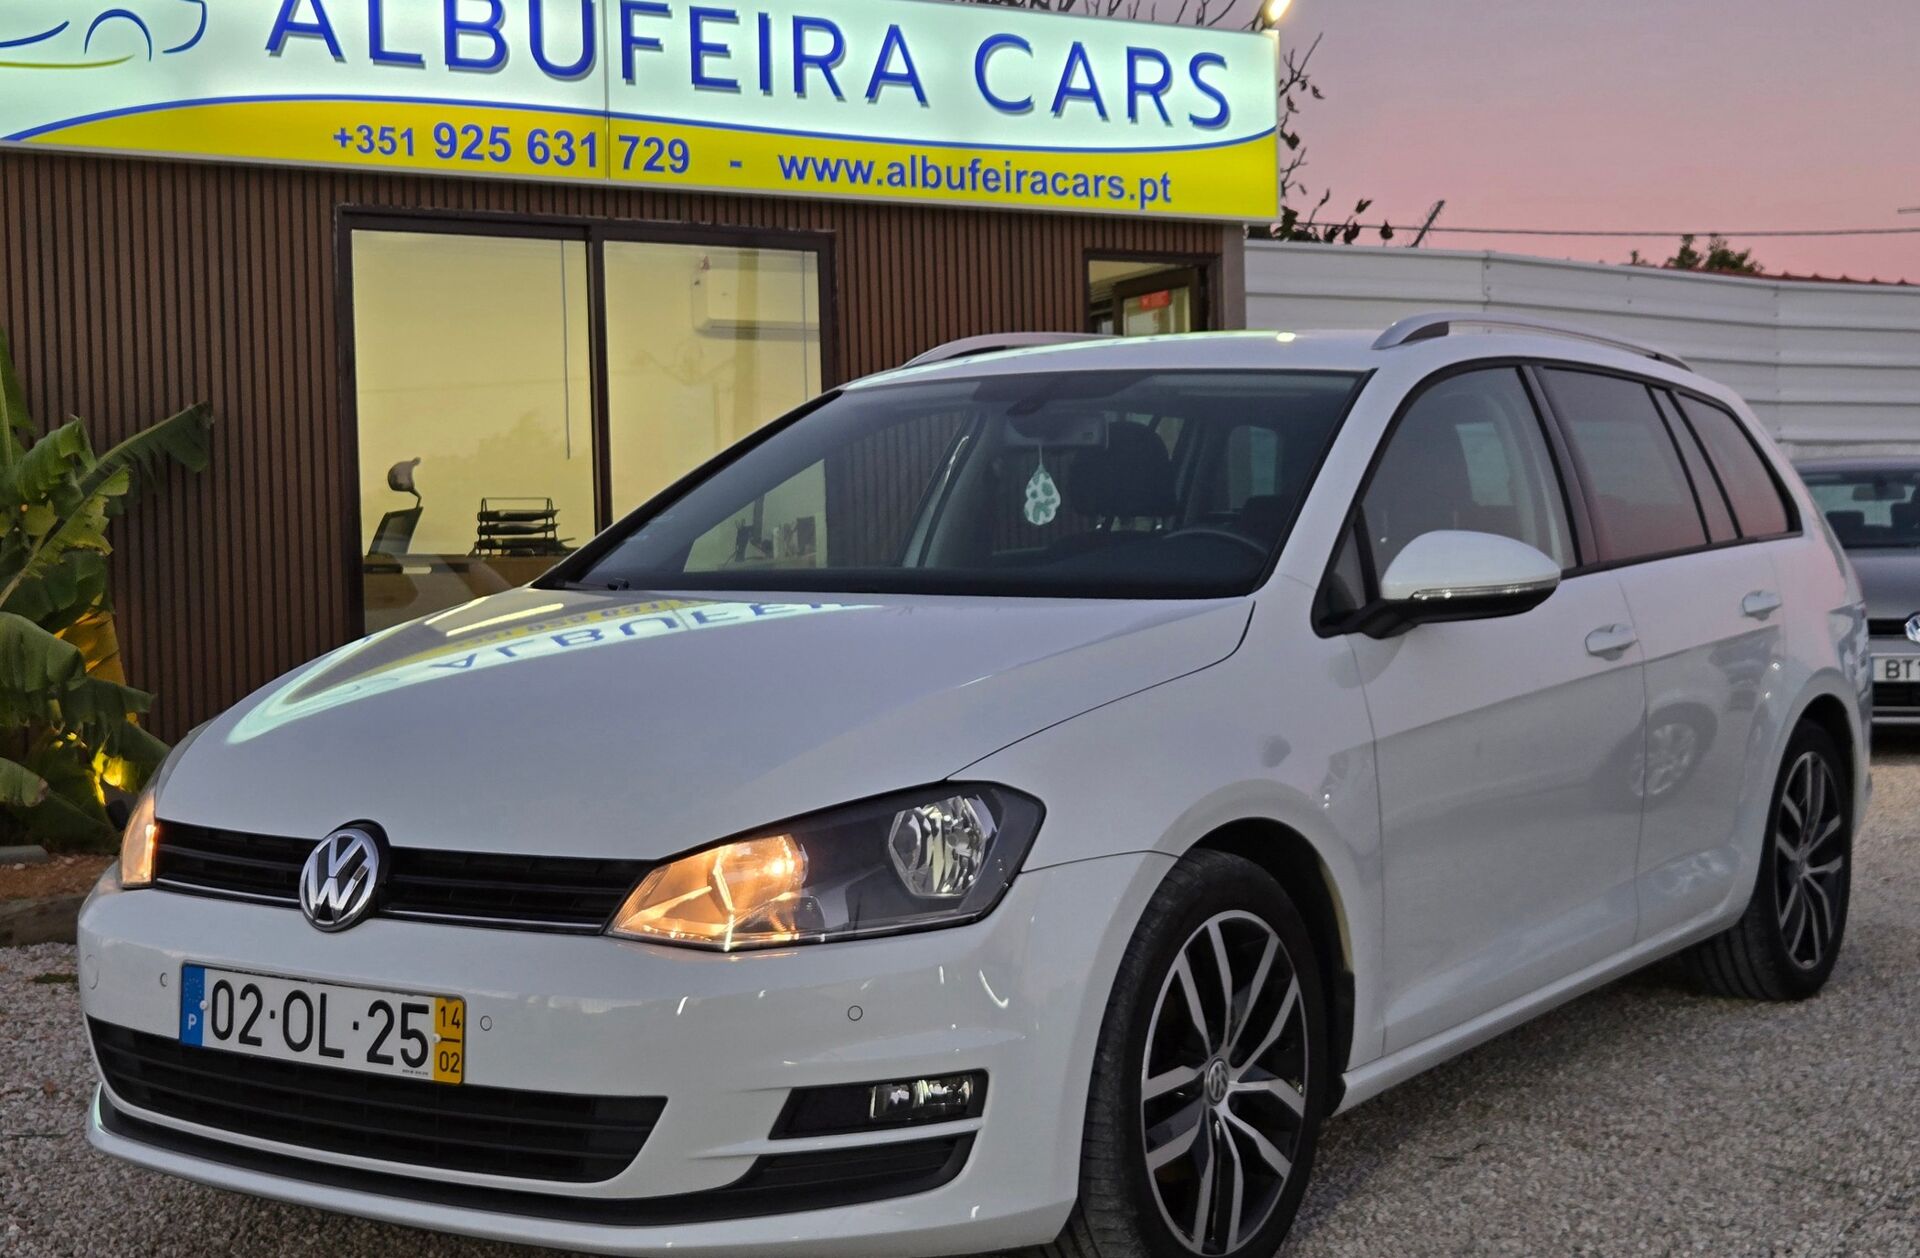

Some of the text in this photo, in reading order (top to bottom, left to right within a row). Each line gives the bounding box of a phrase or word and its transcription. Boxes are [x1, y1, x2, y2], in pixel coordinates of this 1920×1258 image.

[266, 0, 1232, 130] ALBUFEIRA CARS
[332, 125, 415, 157] +351
[433, 122, 512, 163] 925
[526, 129, 598, 168] 631
[618, 135, 690, 174] 729
[778, 153, 1172, 209] www.albufeiracars.pt
[187, 1013, 197, 1031] P
[440, 1005, 461, 1029] 14
[439, 1050, 461, 1073] 02
